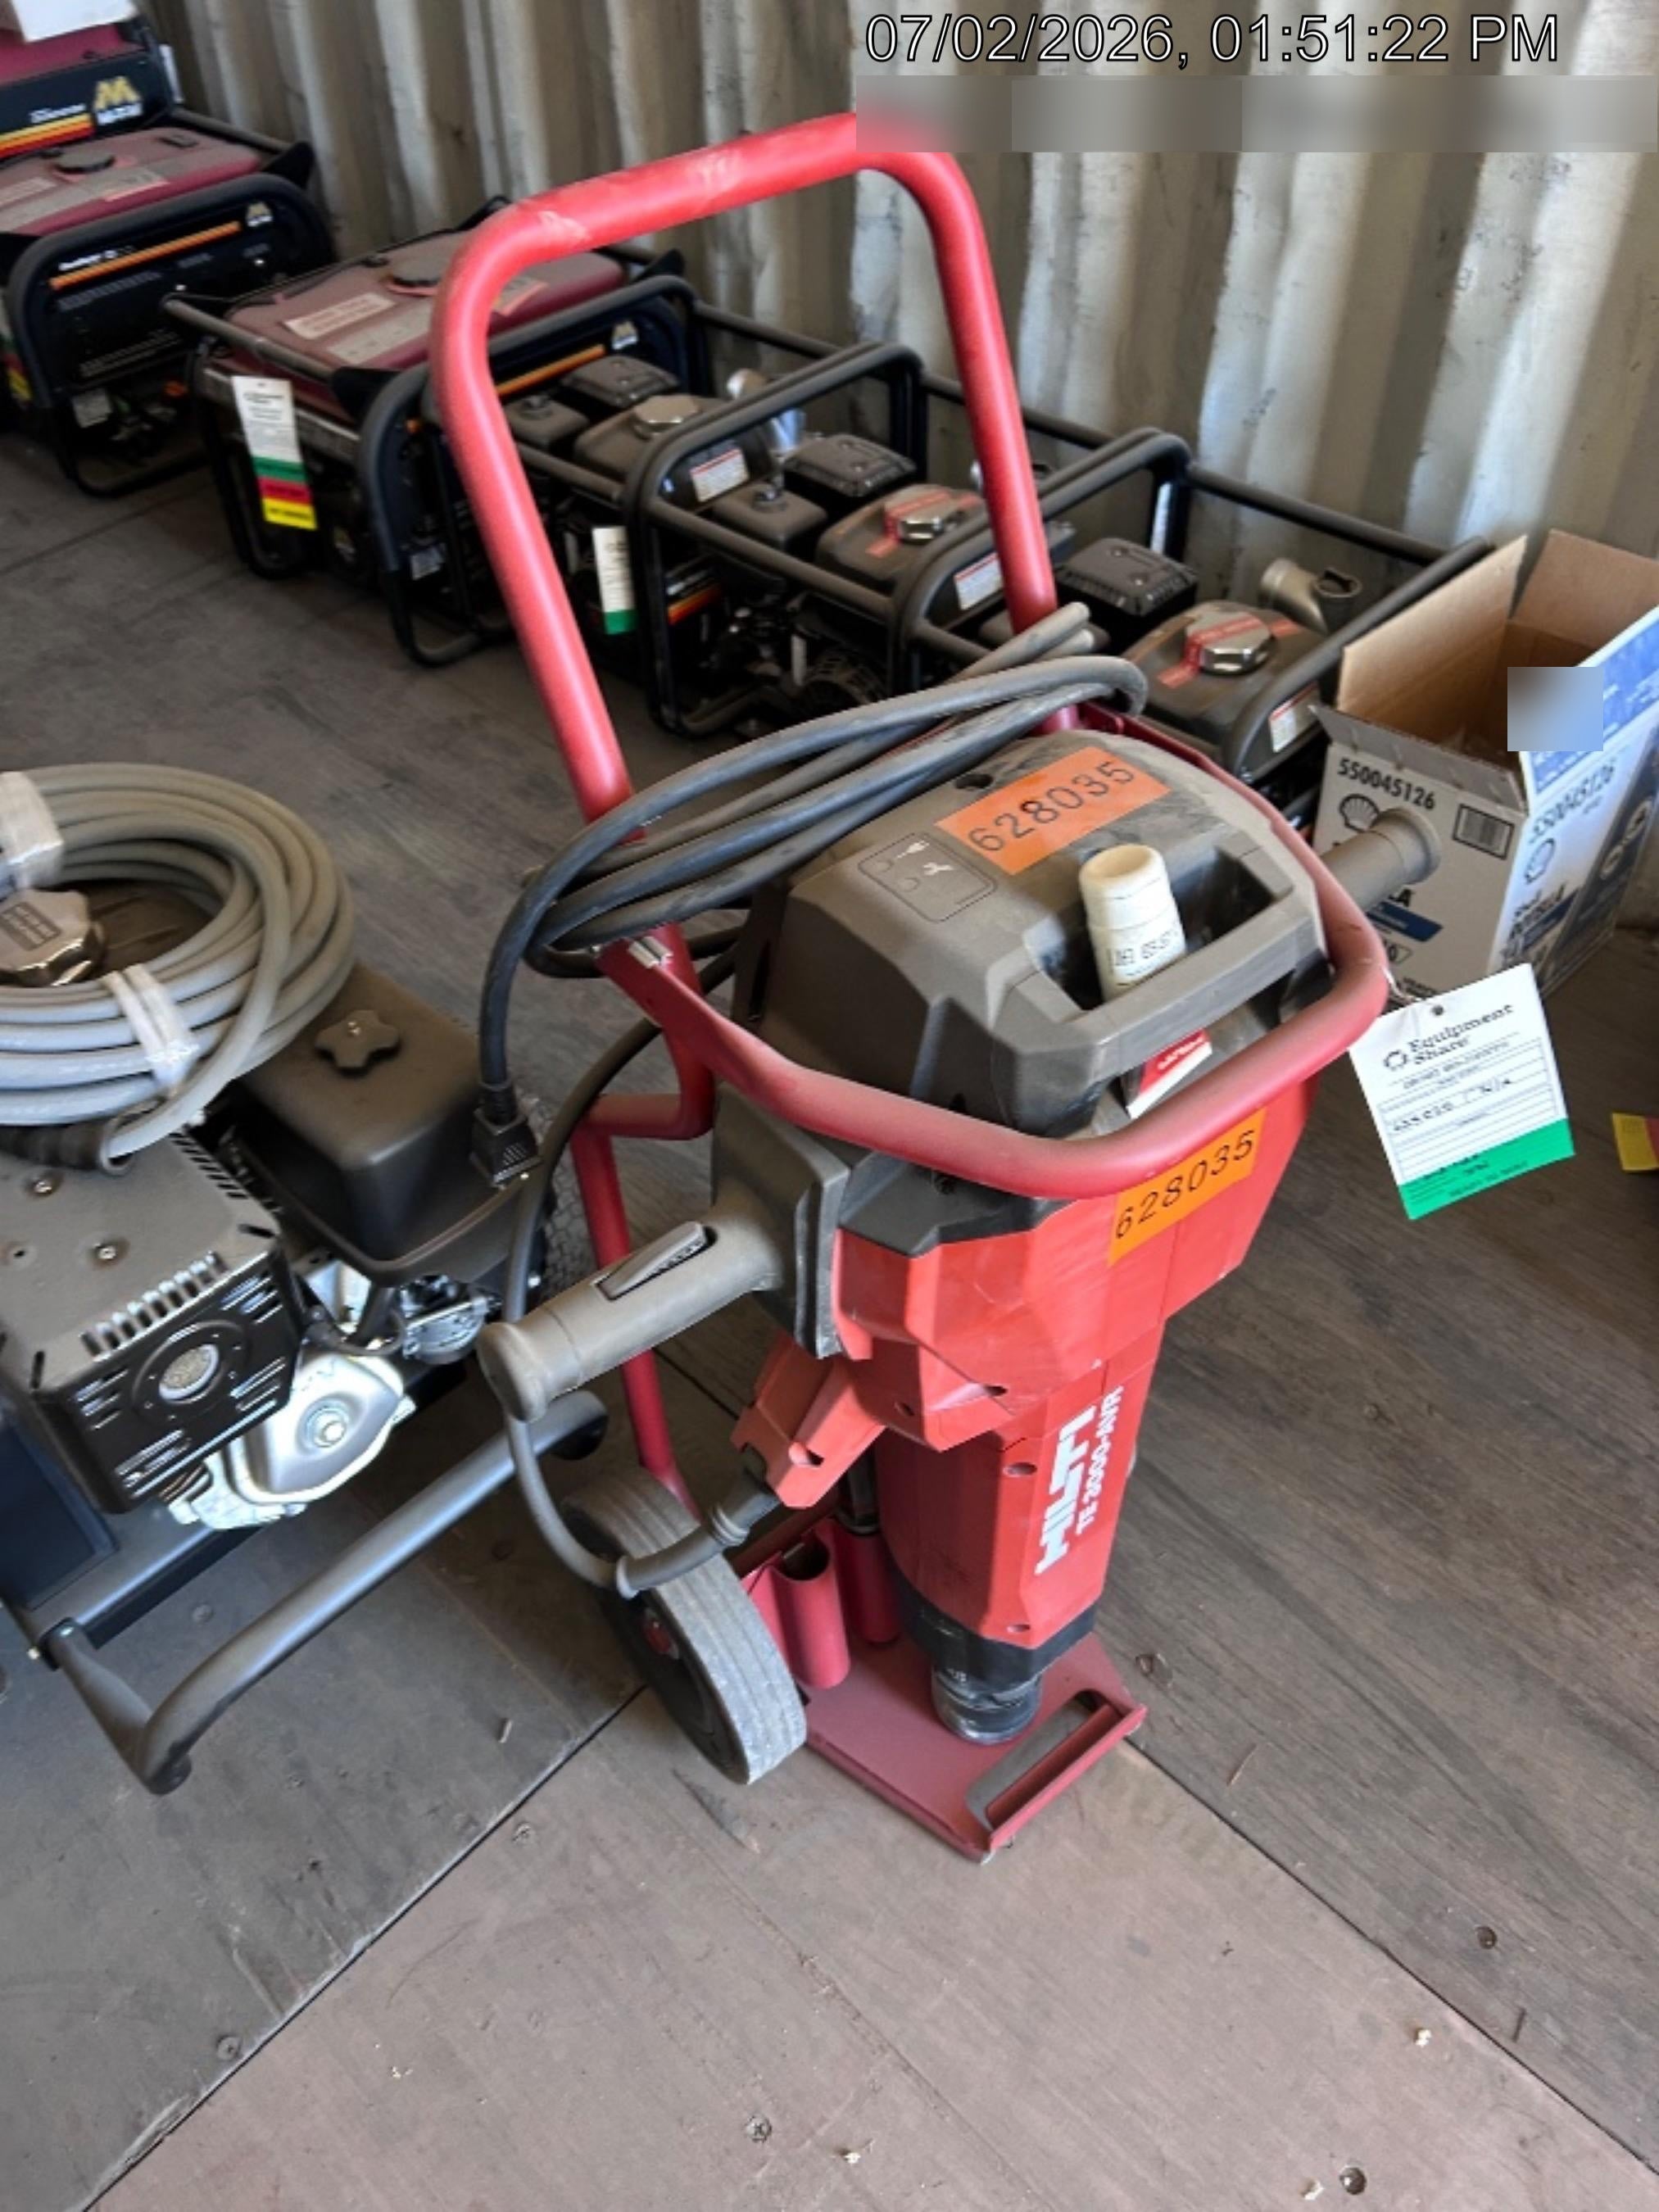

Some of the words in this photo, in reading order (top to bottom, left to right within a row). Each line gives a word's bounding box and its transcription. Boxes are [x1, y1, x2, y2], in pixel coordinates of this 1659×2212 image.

[969, 760, 1135, 853] 628035
[1338, 759, 1435, 812] 550045126
[1408, 1004, 1514, 1053] Equipment
[1114, 1129, 1255, 1240] 628035
[1034, 1404, 1097, 1575] HILTI
